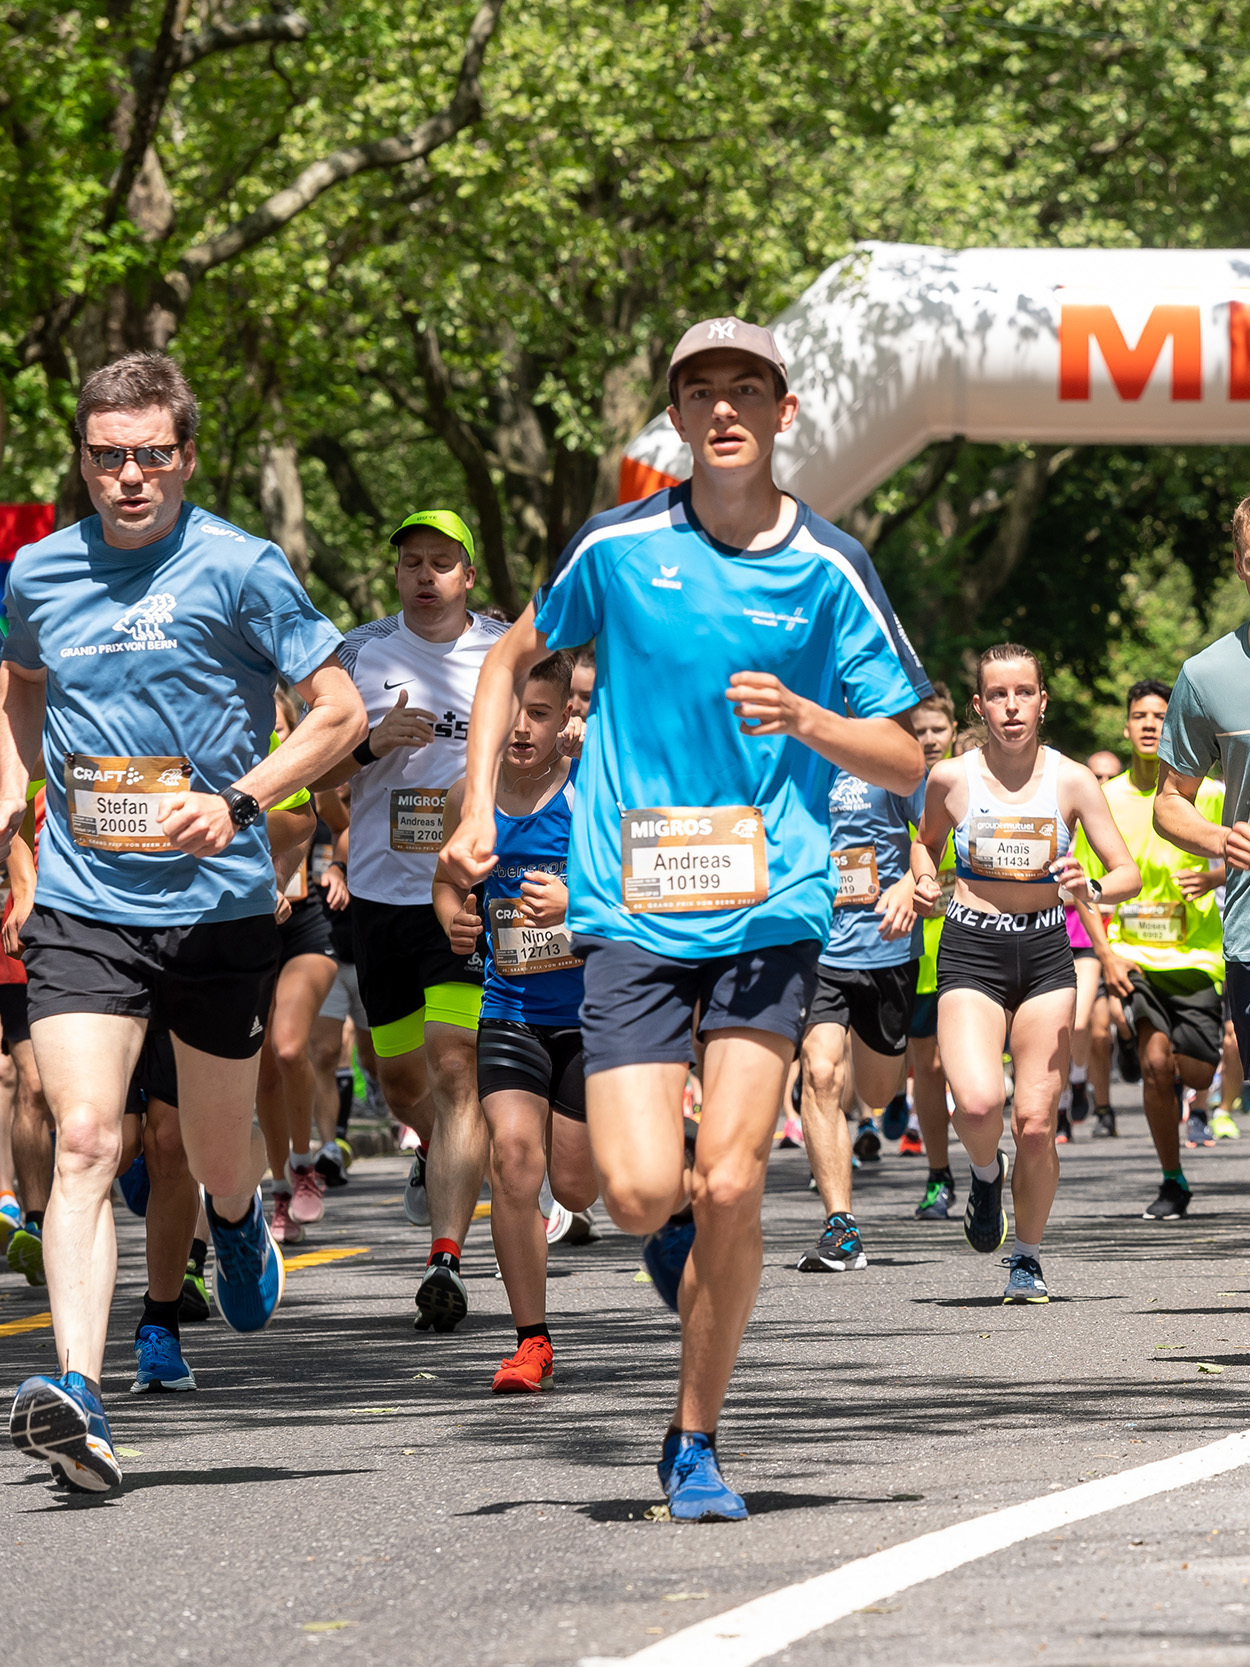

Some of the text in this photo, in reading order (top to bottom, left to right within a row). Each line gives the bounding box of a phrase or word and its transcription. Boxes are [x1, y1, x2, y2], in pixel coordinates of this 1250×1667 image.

[60, 639, 177, 658] GRAND PRIX VON BERN
[72, 766, 127, 783] CRAFT
[97, 797, 148, 815] Stefan
[397, 795, 447, 807] MIGROS
[99, 818, 147, 833] 20005
[400, 816, 435, 827] Andreas
[630, 818, 713, 839] MIGROS
[996, 842, 1030, 855] Anaïs
[653, 852, 732, 871] Andreas
[996, 856, 1030, 867] 11434
[666, 874, 721, 890] 10199
[495, 909, 524, 920] CRA
[980, 912, 1029, 932] PRO
[521, 930, 554, 944] Nino
[520, 943, 561, 959] 12713
